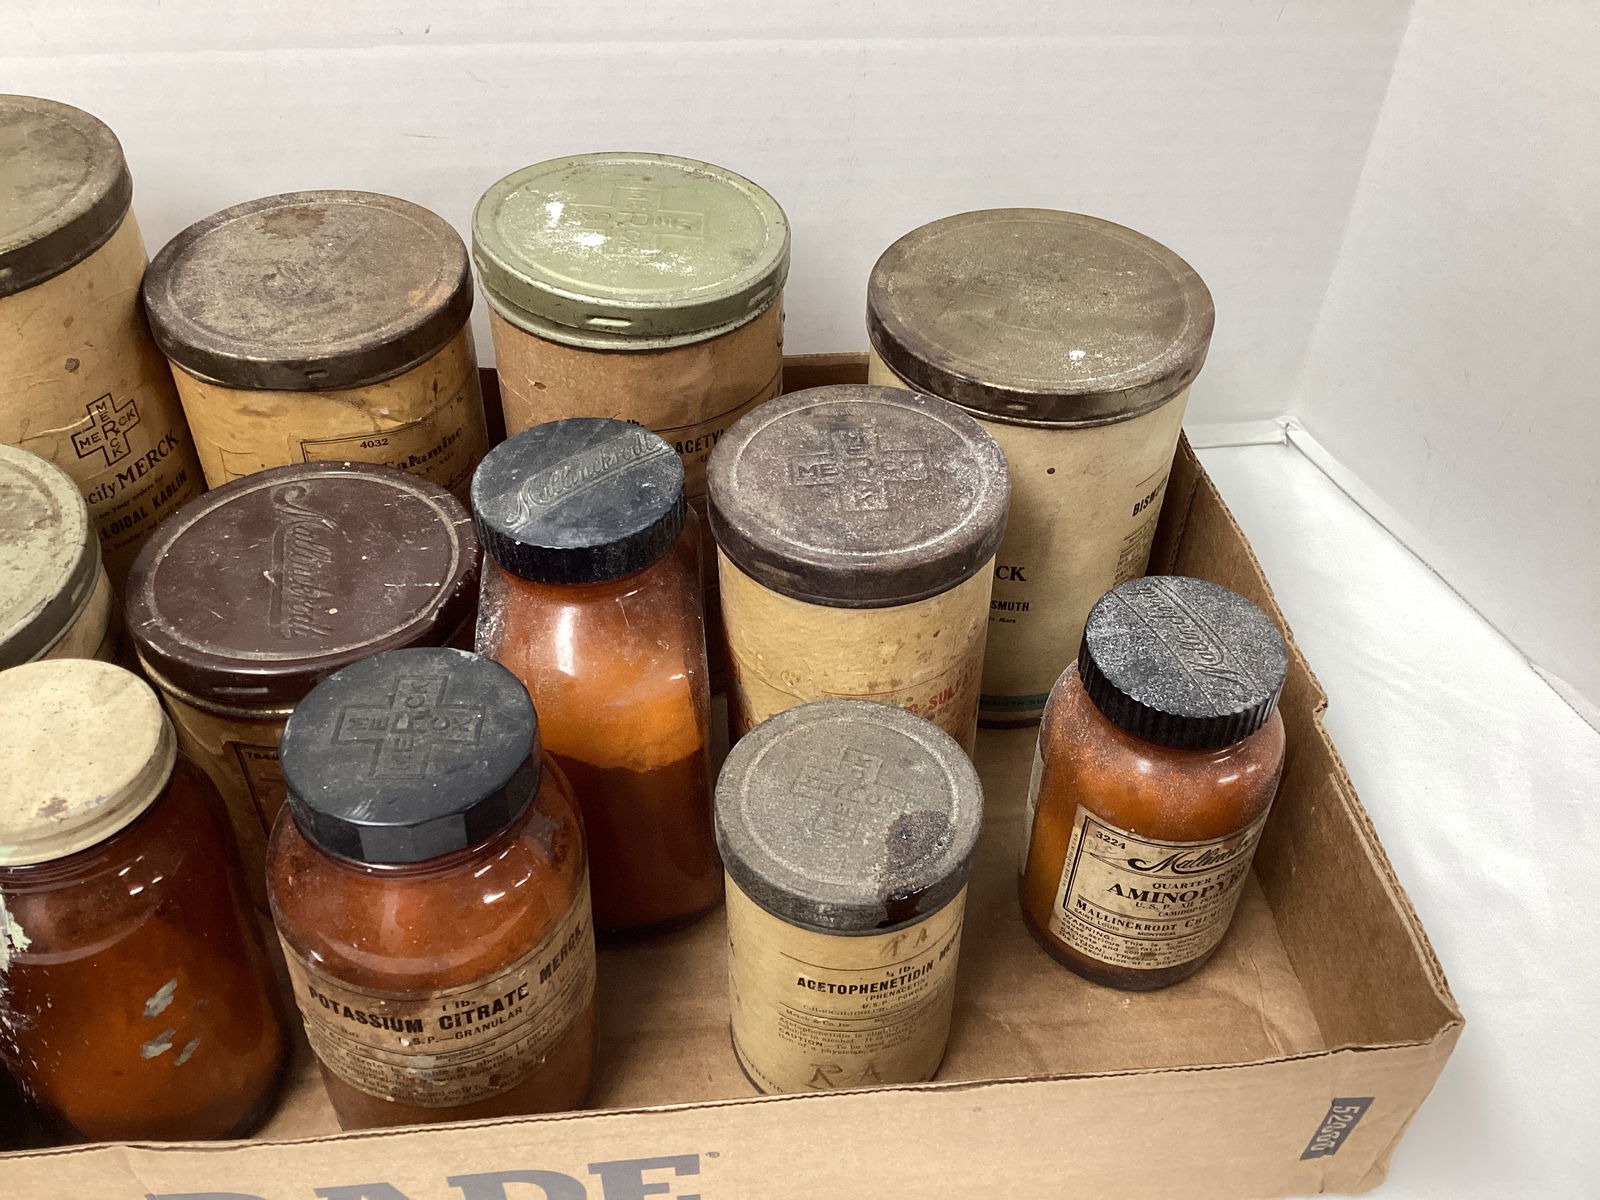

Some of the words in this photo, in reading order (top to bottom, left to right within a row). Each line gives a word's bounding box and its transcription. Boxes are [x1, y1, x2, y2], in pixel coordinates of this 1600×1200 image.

[359, 438, 389, 449] 4032
[84, 481, 116, 505] cify
[115, 429, 181, 490] MERCK
[100, 506, 148, 541] LOIDAL
[151, 470, 187, 510] KAOLIN
[990, 600, 1030, 612] SMUTH
[1095, 830, 1126, 850] 3224
[1152, 877, 1212, 890] QUARTER
[1064, 912, 1114, 940] WARNING:
[1074, 907, 1094, 921] SAINT
[1097, 920, 1120, 931] LOUIS
[1075, 899, 1178, 931] MALLINCKRODT
[797, 960, 934, 995] ACETOPHENETIDIN
[308, 984, 424, 1034] POTASSIUM
[439, 982, 529, 1031] CITRATE
